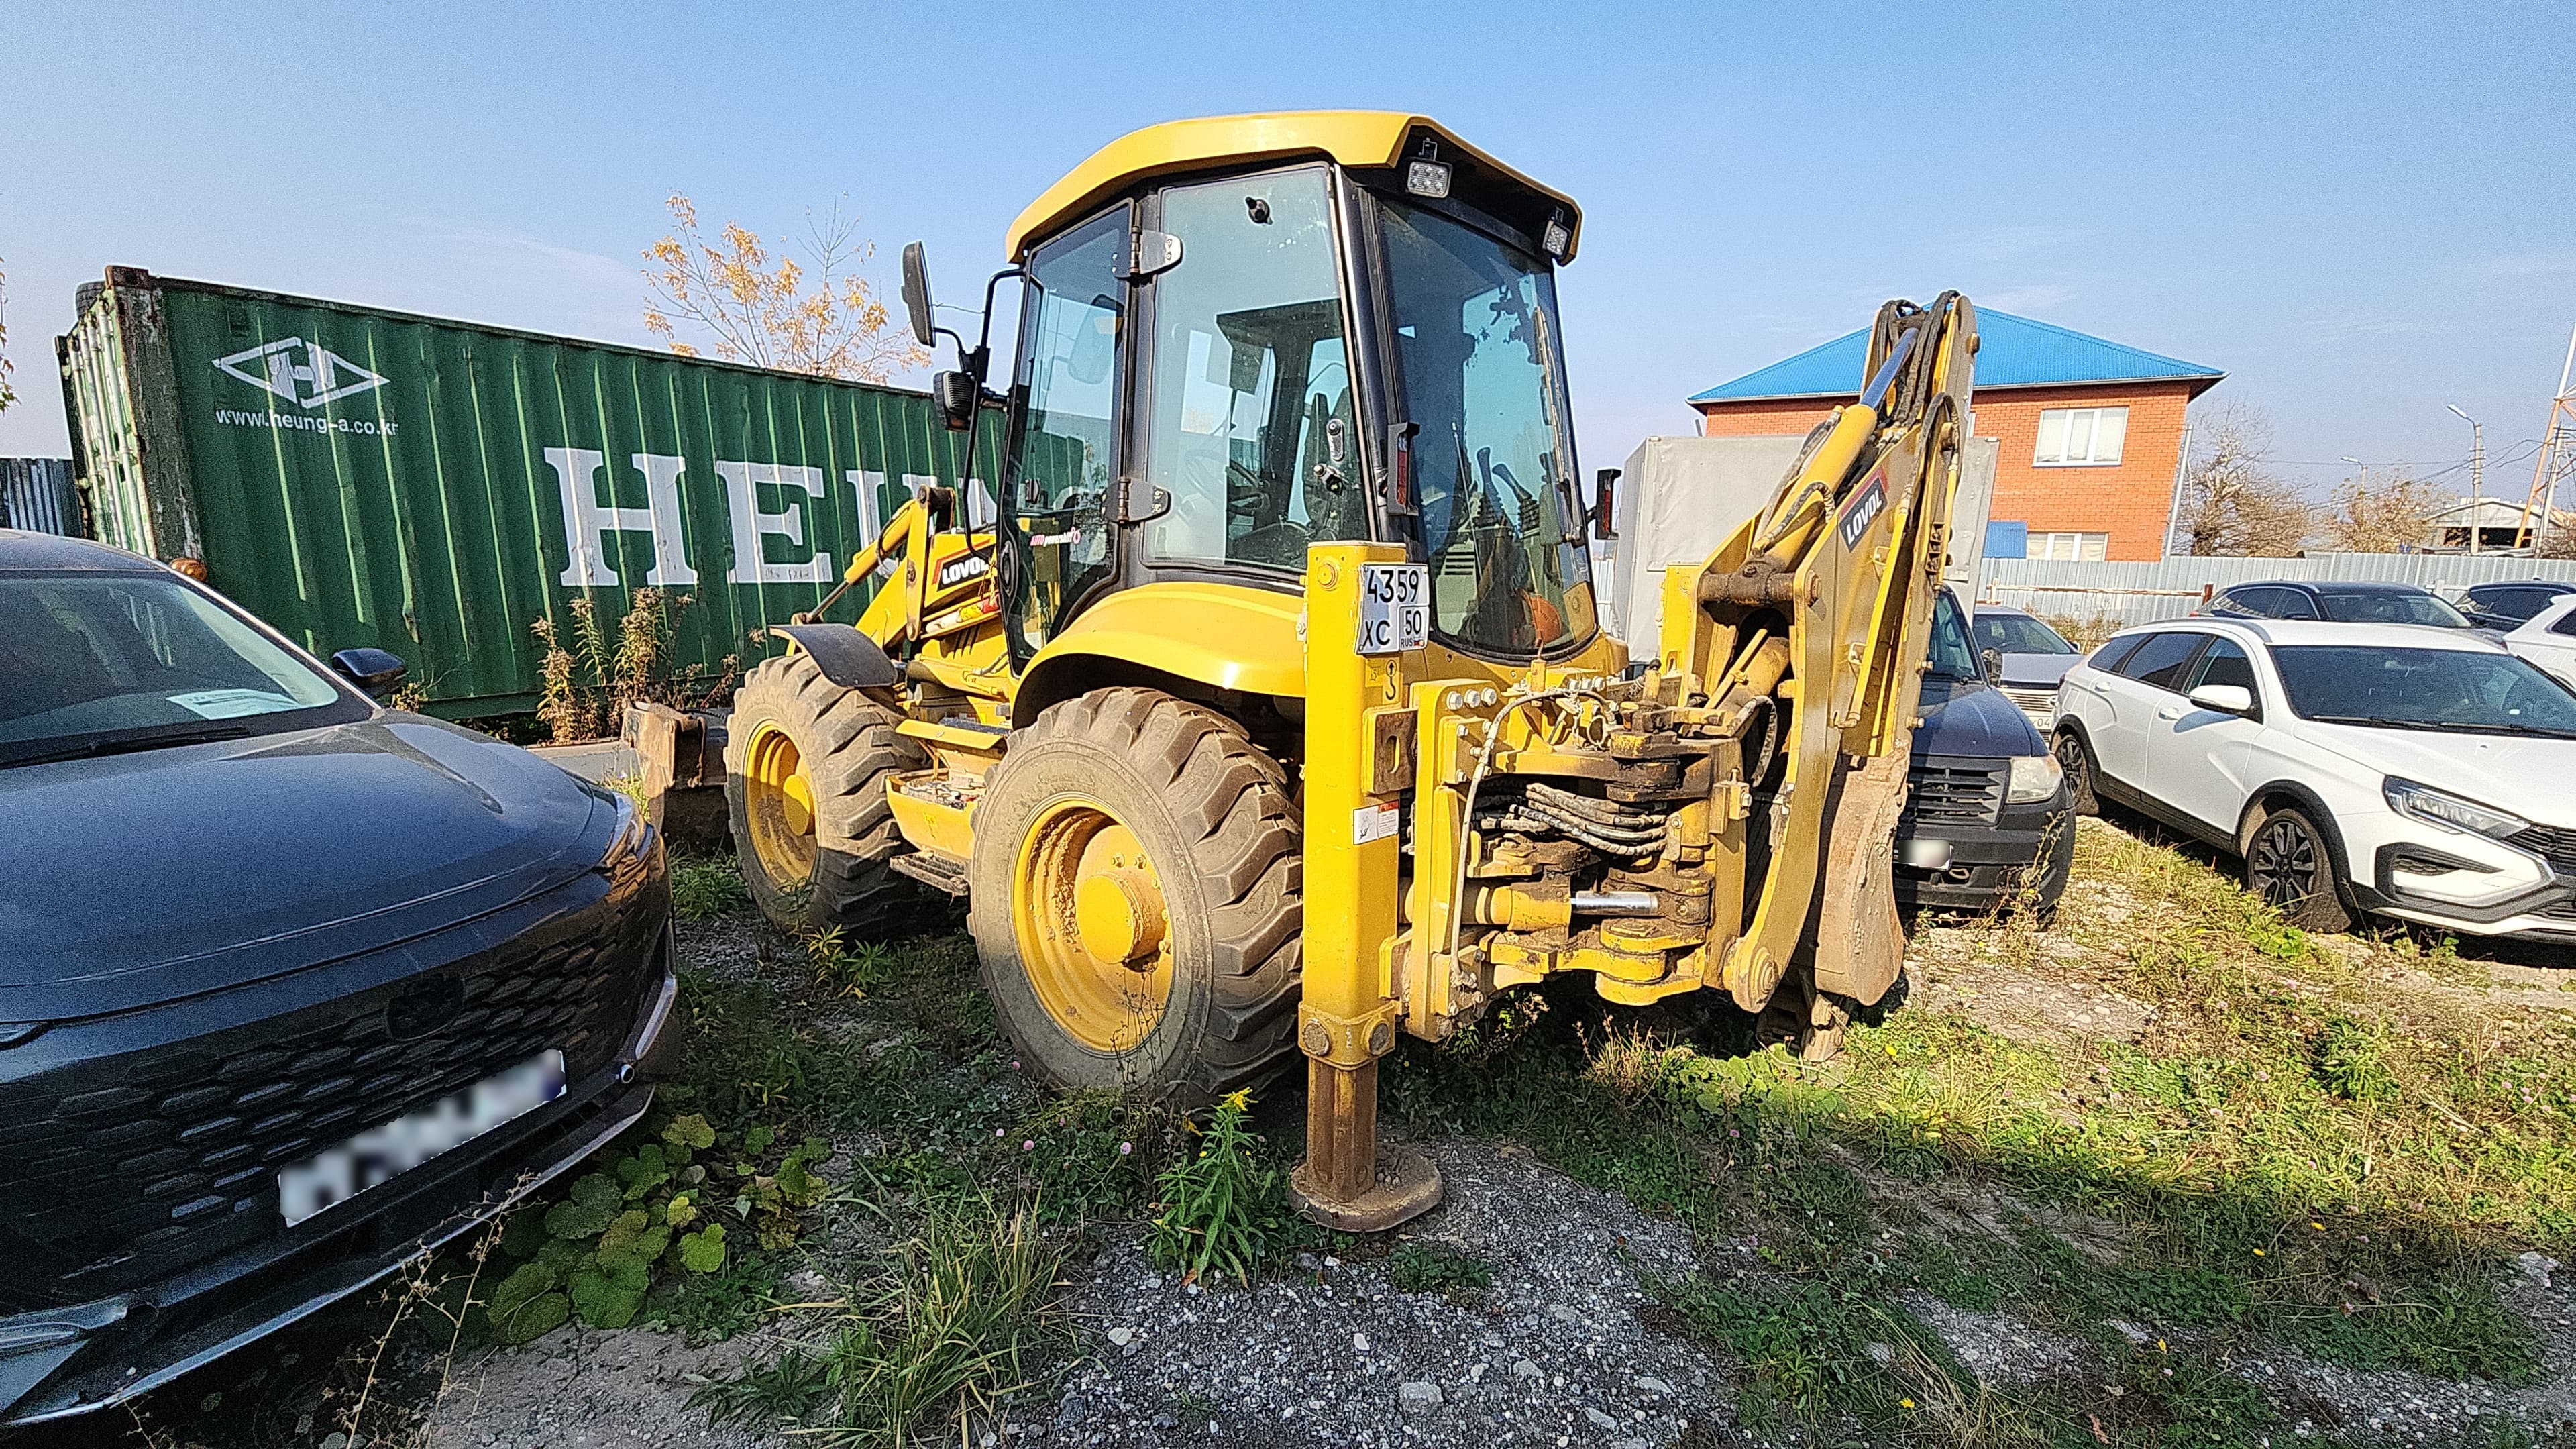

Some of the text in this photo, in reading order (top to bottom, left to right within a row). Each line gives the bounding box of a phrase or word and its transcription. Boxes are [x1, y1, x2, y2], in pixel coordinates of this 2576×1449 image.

[215, 407, 398, 436] www.heung-a.co.kr
[1846, 489, 1882, 545] LOVOL
[1367, 569, 1419, 604] 4359
[1363, 610, 1422, 647] ХС 50
[1400, 638, 1413, 647] RUS
